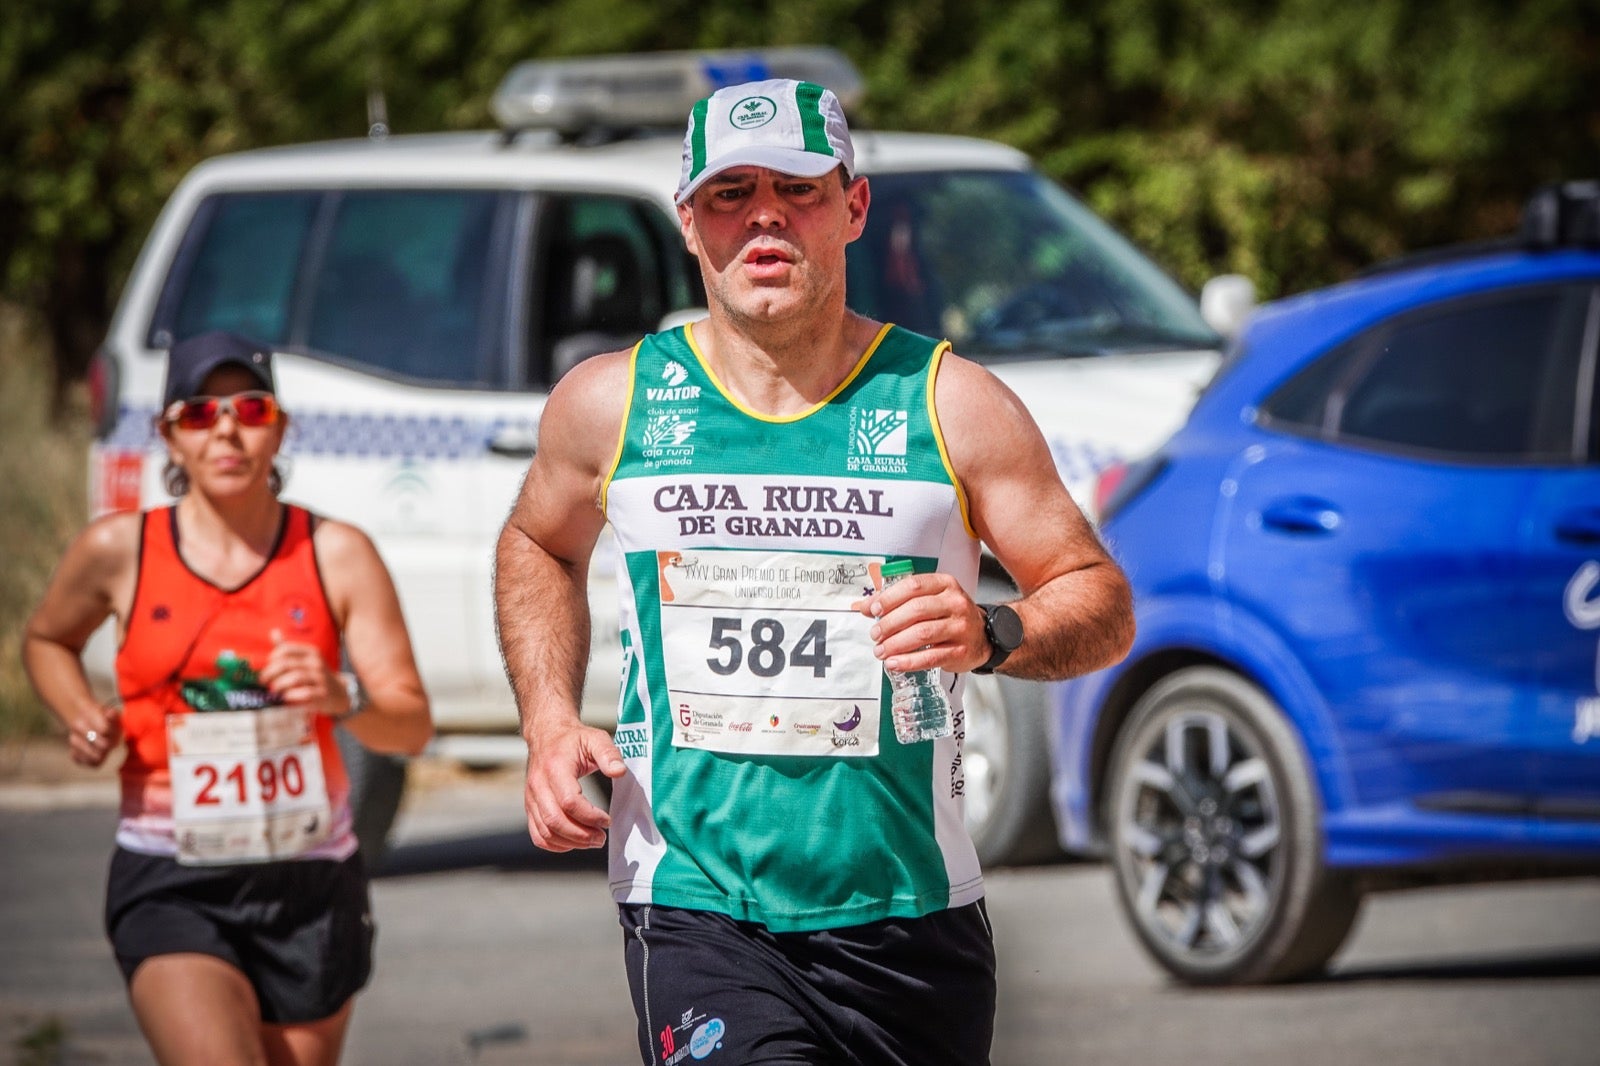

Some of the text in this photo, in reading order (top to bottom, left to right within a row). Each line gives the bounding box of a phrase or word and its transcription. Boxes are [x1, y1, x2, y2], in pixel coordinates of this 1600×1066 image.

[647, 386, 701, 400] VIATOR
[647, 407, 665, 415] club
[666, 407, 677, 415] de
[643, 446, 694, 457] caja rural
[644, 457, 692, 469] de granada
[862, 465, 907, 473] GRANADA
[653, 484, 893, 518] CAJA RURAL
[678, 516, 865, 541] DE GRANADA
[684, 564, 709, 581] XXXV
[706, 617, 832, 678] 584
[193, 755, 305, 805] 2190
[660, 1024, 675, 1060] 30
